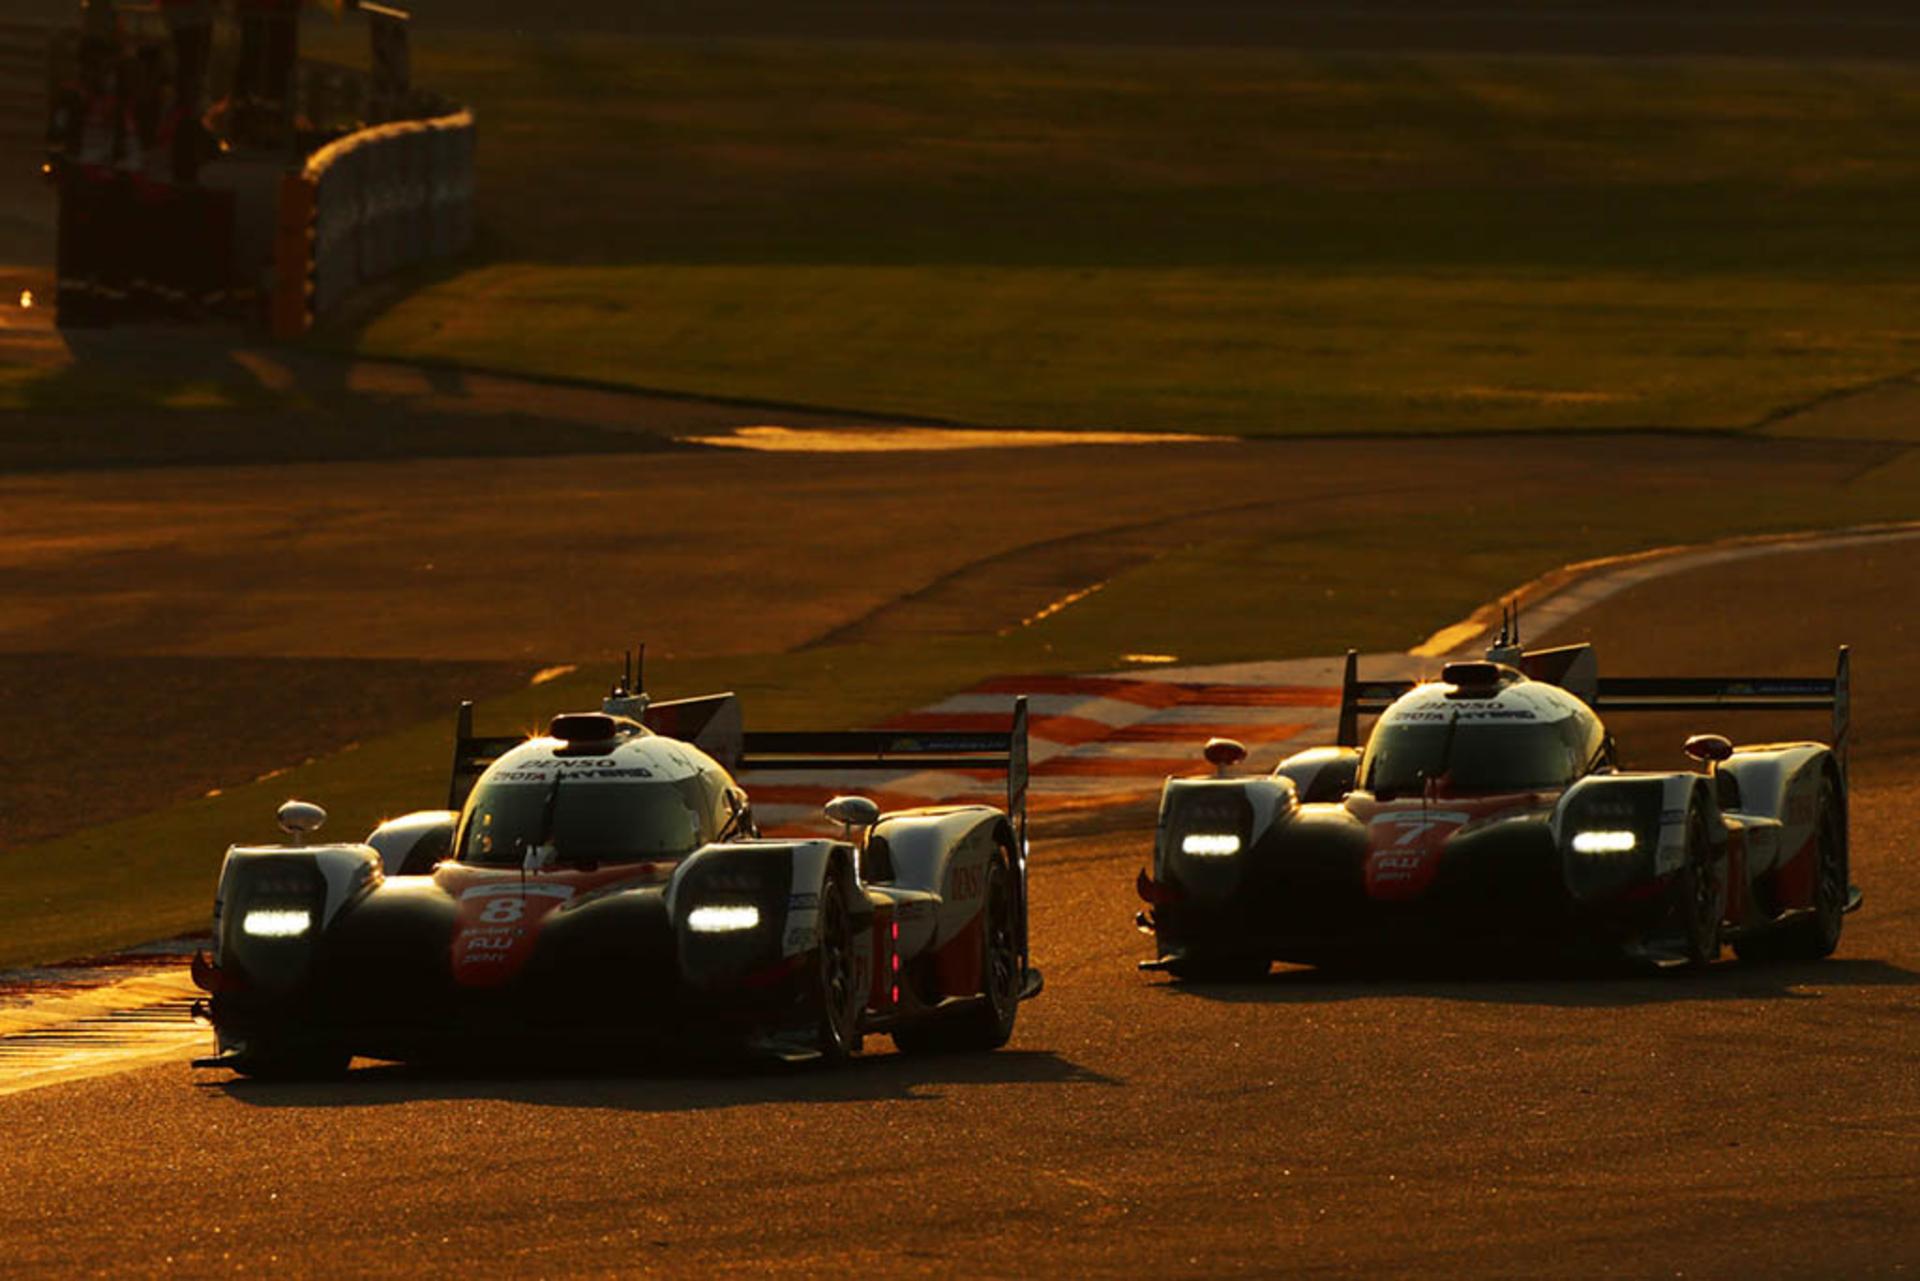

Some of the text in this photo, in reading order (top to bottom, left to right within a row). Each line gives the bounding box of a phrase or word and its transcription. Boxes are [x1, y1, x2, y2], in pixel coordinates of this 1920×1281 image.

[519, 759, 615, 769] DENSO
[1394, 821, 1436, 845] 7
[481, 898, 526, 922] 8
